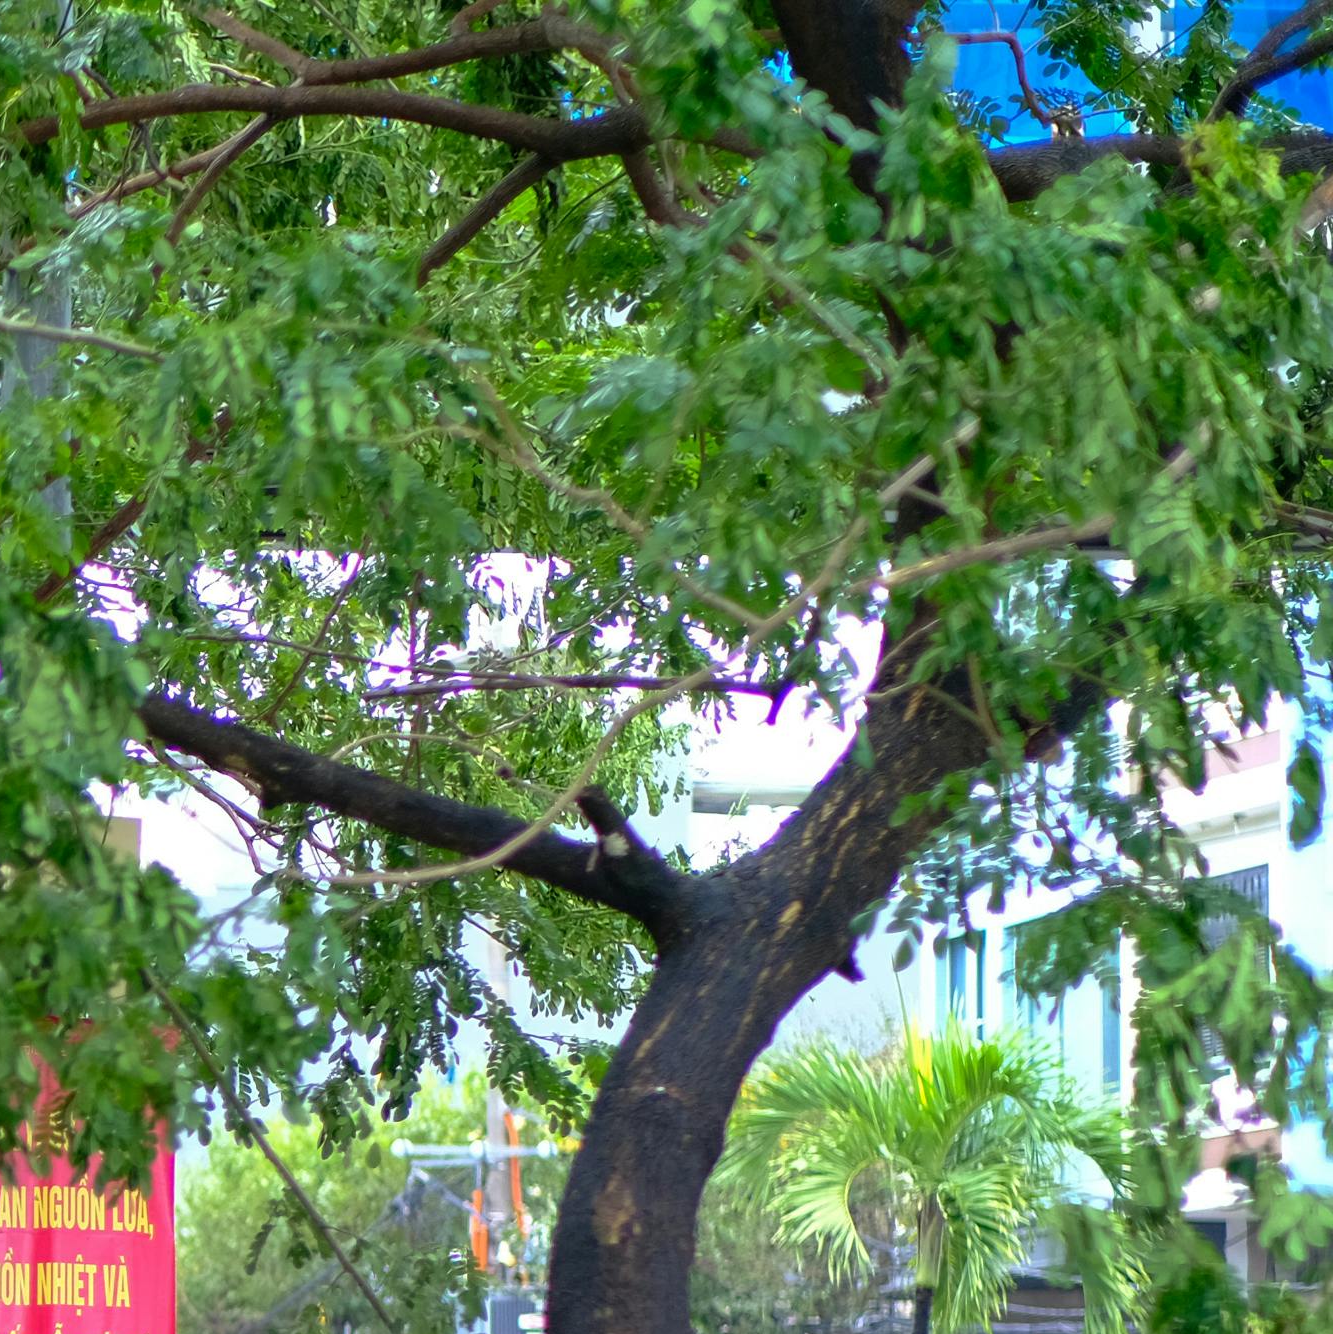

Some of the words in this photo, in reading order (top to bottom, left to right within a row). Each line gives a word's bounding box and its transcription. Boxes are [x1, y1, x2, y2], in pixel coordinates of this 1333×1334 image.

[33, 1173, 106, 1231] NGUỒN
[37, 1254, 97, 1316] NHIỆT
[103, 1256, 131, 1308] VÀ
